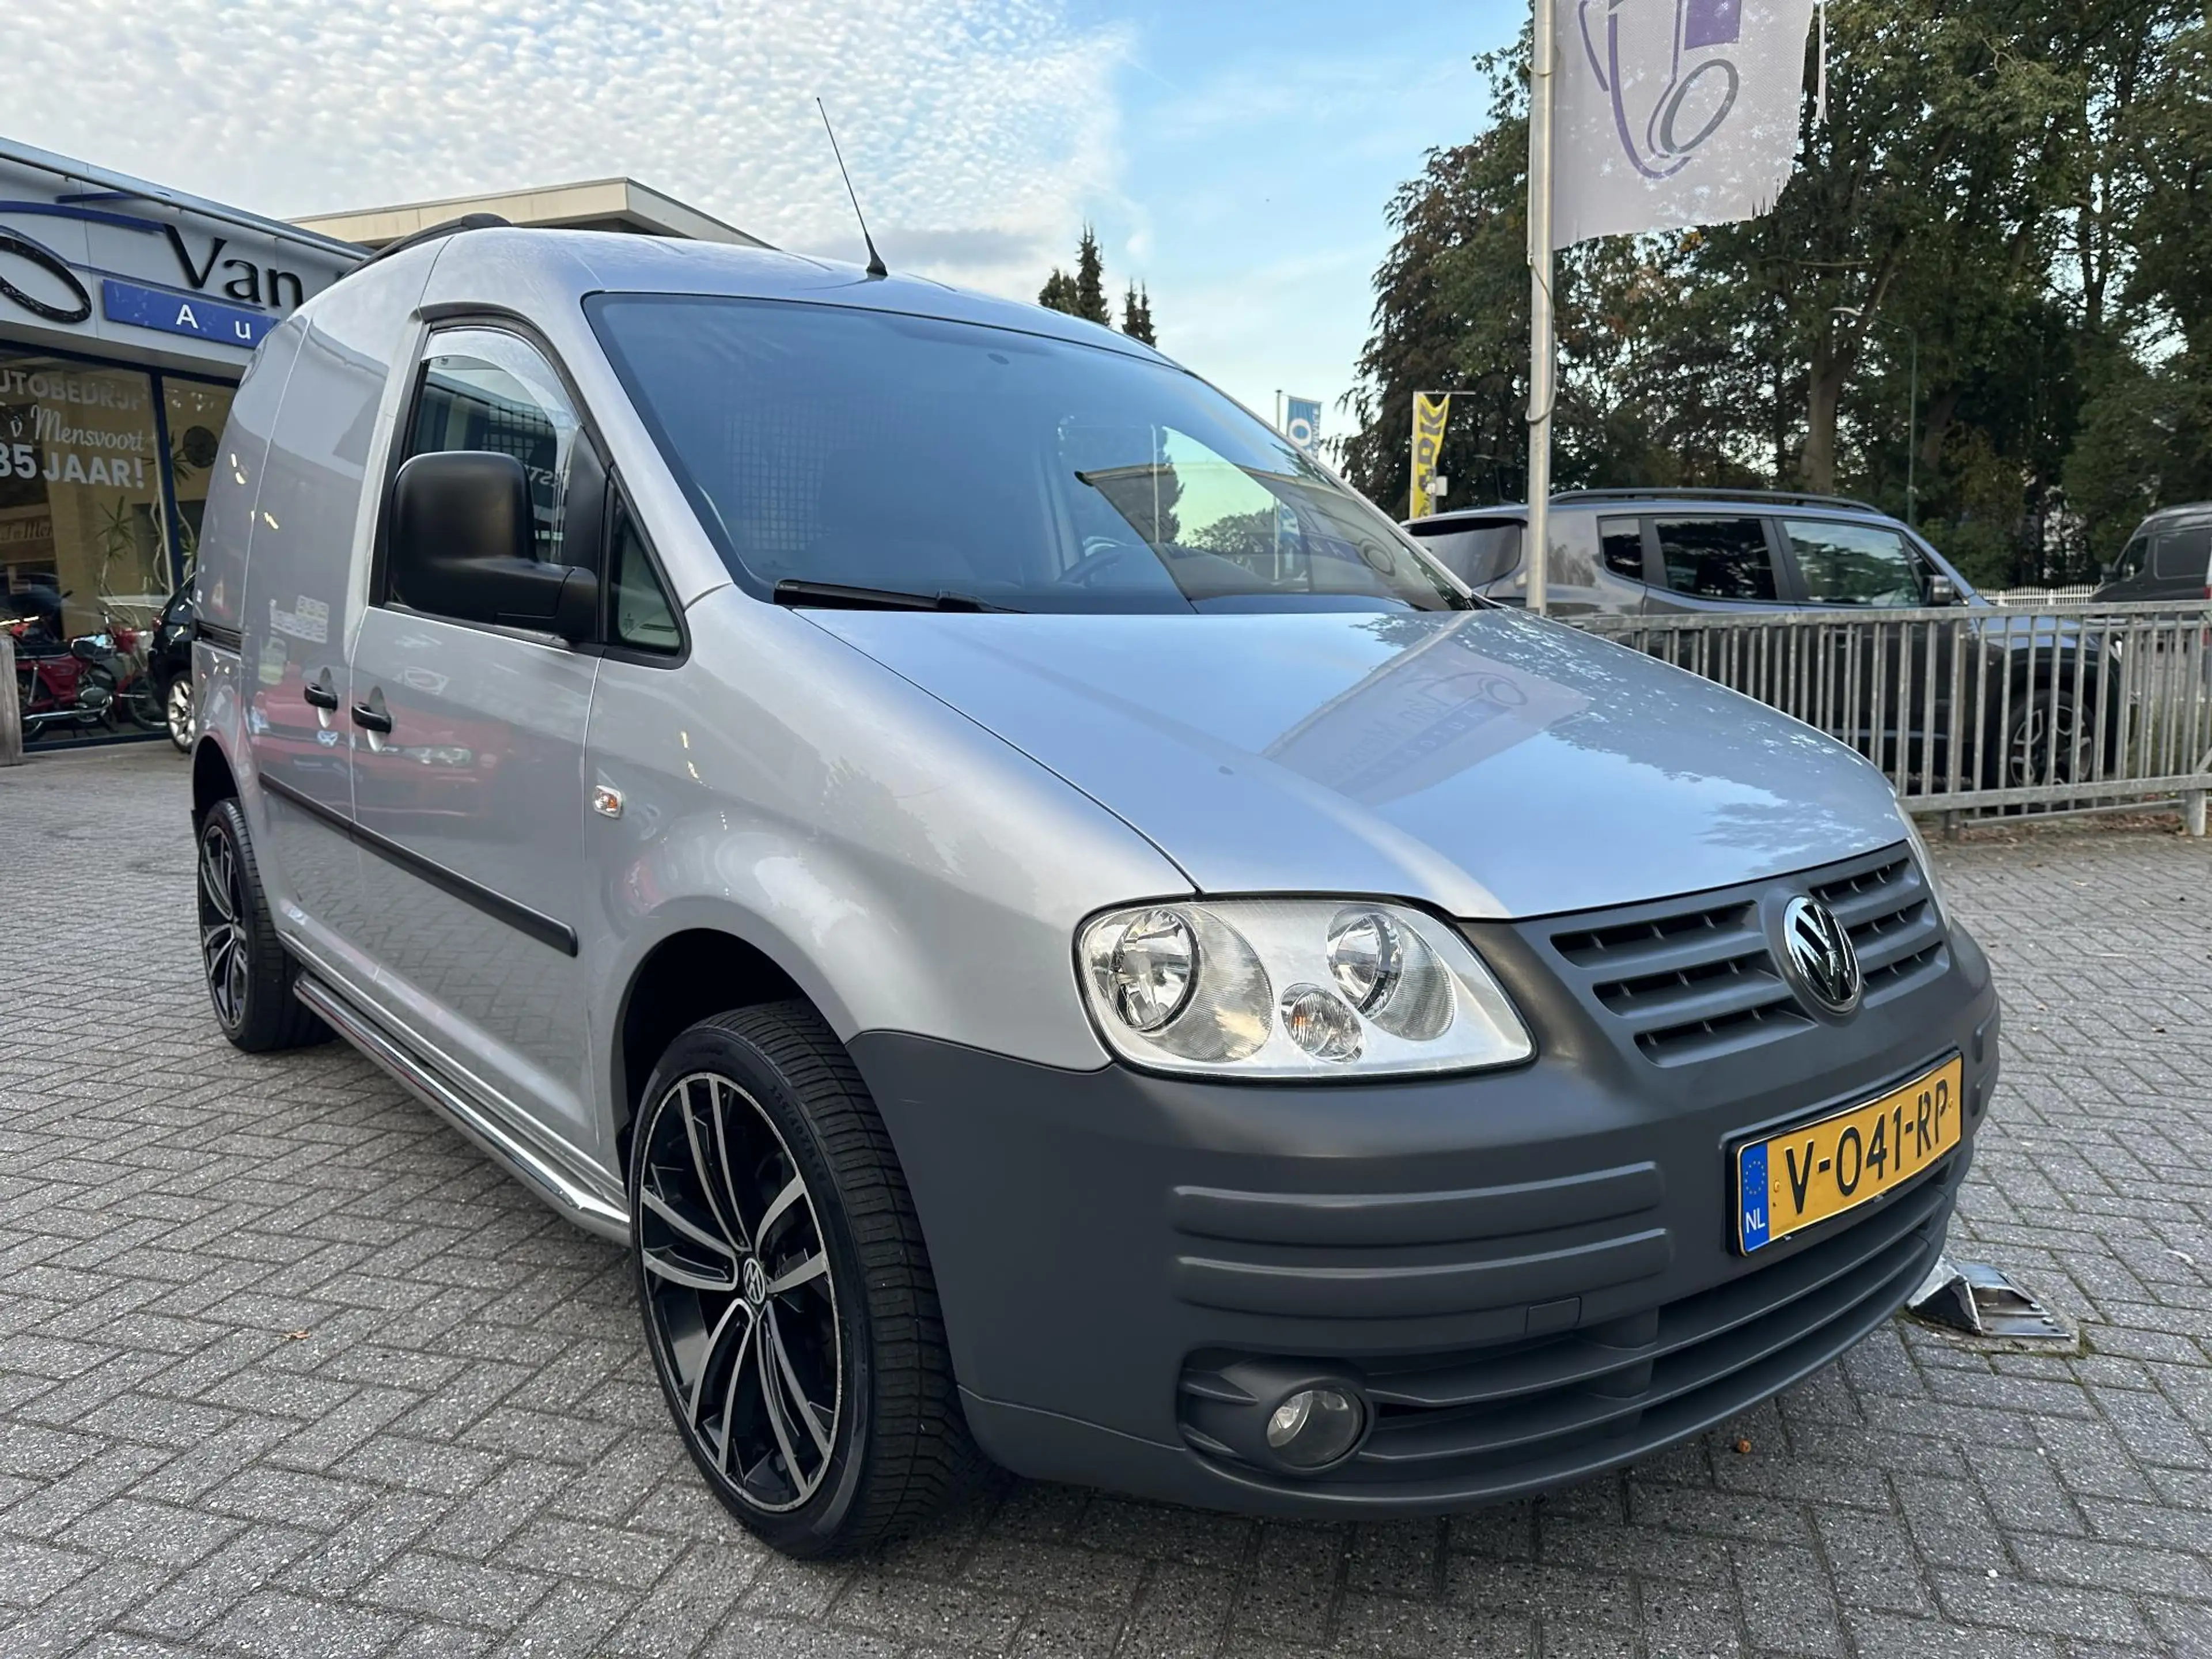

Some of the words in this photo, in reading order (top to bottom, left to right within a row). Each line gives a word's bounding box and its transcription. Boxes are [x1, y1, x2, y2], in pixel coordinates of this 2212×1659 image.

[164, 223, 304, 307] Van
[31, 404, 145, 451] Mensvoort
[43, 452, 145, 488] JAAR!
[1785, 1077, 1949, 1215] V-041-RP
[1745, 1207, 1766, 1234] NL
